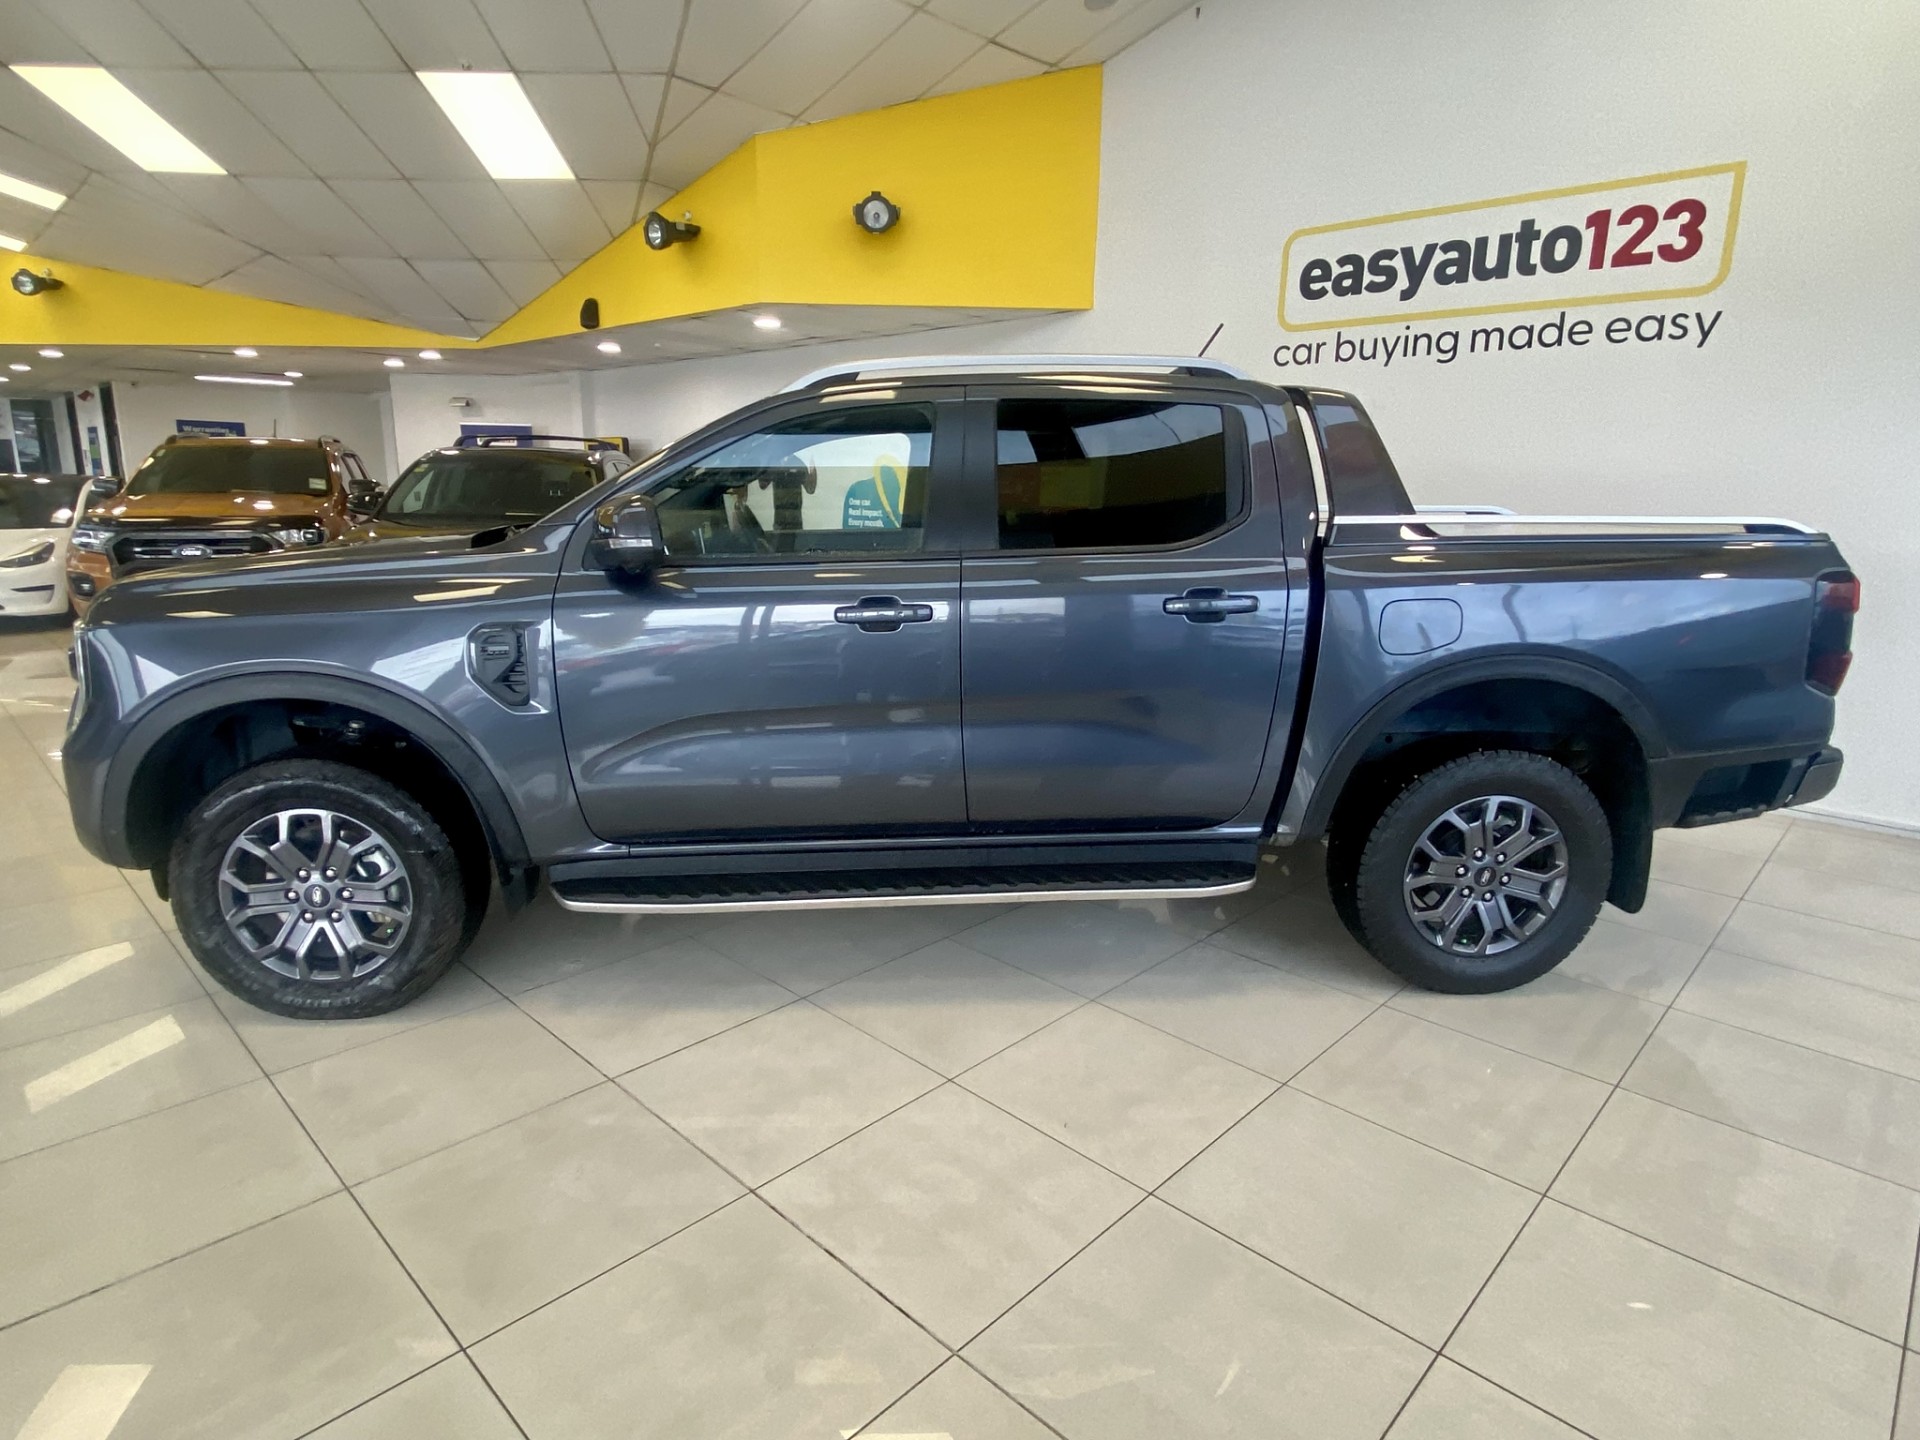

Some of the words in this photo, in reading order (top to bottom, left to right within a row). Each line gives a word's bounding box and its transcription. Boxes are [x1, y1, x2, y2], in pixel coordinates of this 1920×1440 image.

[1299, 198, 1707, 302] easyauto123
[1273, 341, 1327, 367] car
[1334, 326, 1459, 367] buying
[1470, 312, 1594, 353] made
[1605, 310, 1723, 348] easy
